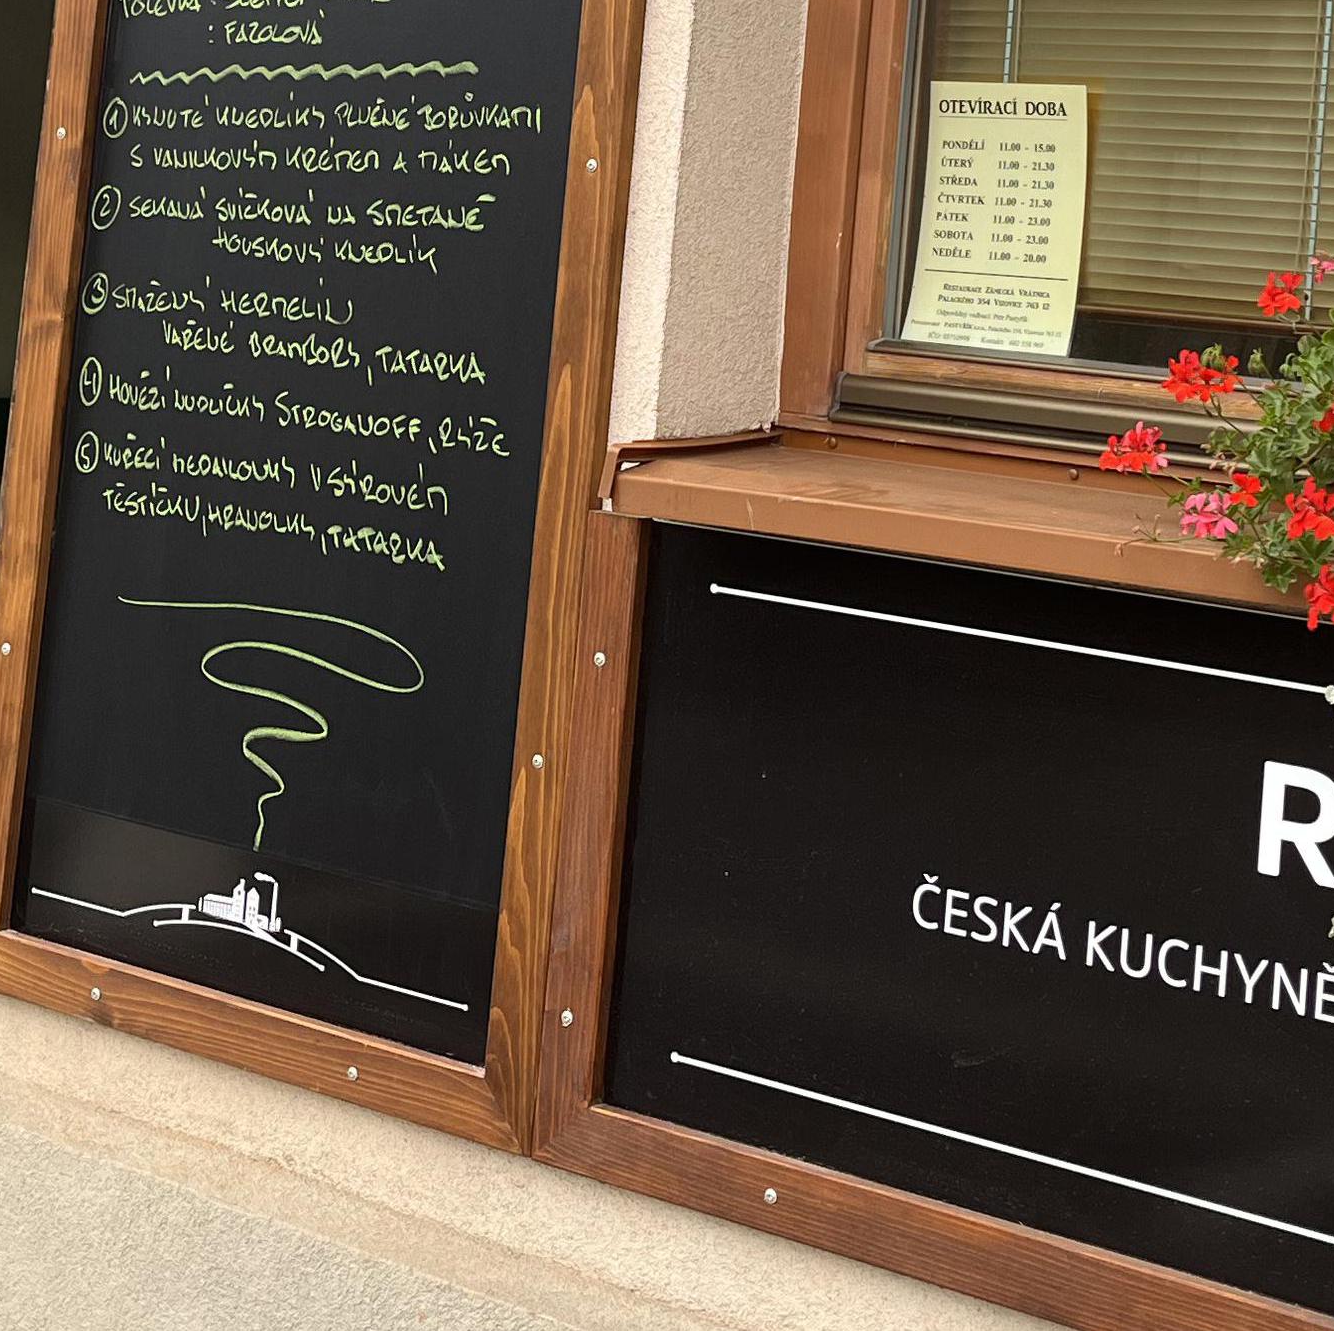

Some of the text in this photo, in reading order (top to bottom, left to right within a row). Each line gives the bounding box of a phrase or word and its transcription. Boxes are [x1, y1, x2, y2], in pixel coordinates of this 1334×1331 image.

[223, 8, 326, 46] FAZOLOVÁ
[132, 94, 210, 130] KYNUTÉ
[216, 91, 326, 131] KNEDLÍKY
[416, 91, 542, 135] BORŮVKAMI
[938, 96, 1067, 117] OTEVÍRACÍ DOBA
[129, 135, 511, 176] S VANILKOVÝM KRÉMEM A MÁKEM
[128, 185, 208, 220] SEKANÁ
[215, 186, 315, 226] SVÍČKOVÁ
[327, 205, 357, 226] NA
[212, 226, 438, 276] HOUSKOVÝ KNEDLÍK
[111, 275, 211, 314] SMAŽENÝ
[220, 276, 355, 325] HERMELÍN
[162, 319, 235, 353] VAŘENÉ
[374, 345, 487, 386] TATARKA
[109, 365, 171, 411] HOVĚZÍ
[173, 382, 265, 423] NUDLIČKY
[103, 432, 167, 471] KUŘECÍ
[310, 463, 322, 492] V
[327, 459, 449, 517] SÝROVÉM
[910, 872, 1067, 960] ČESKÁ
